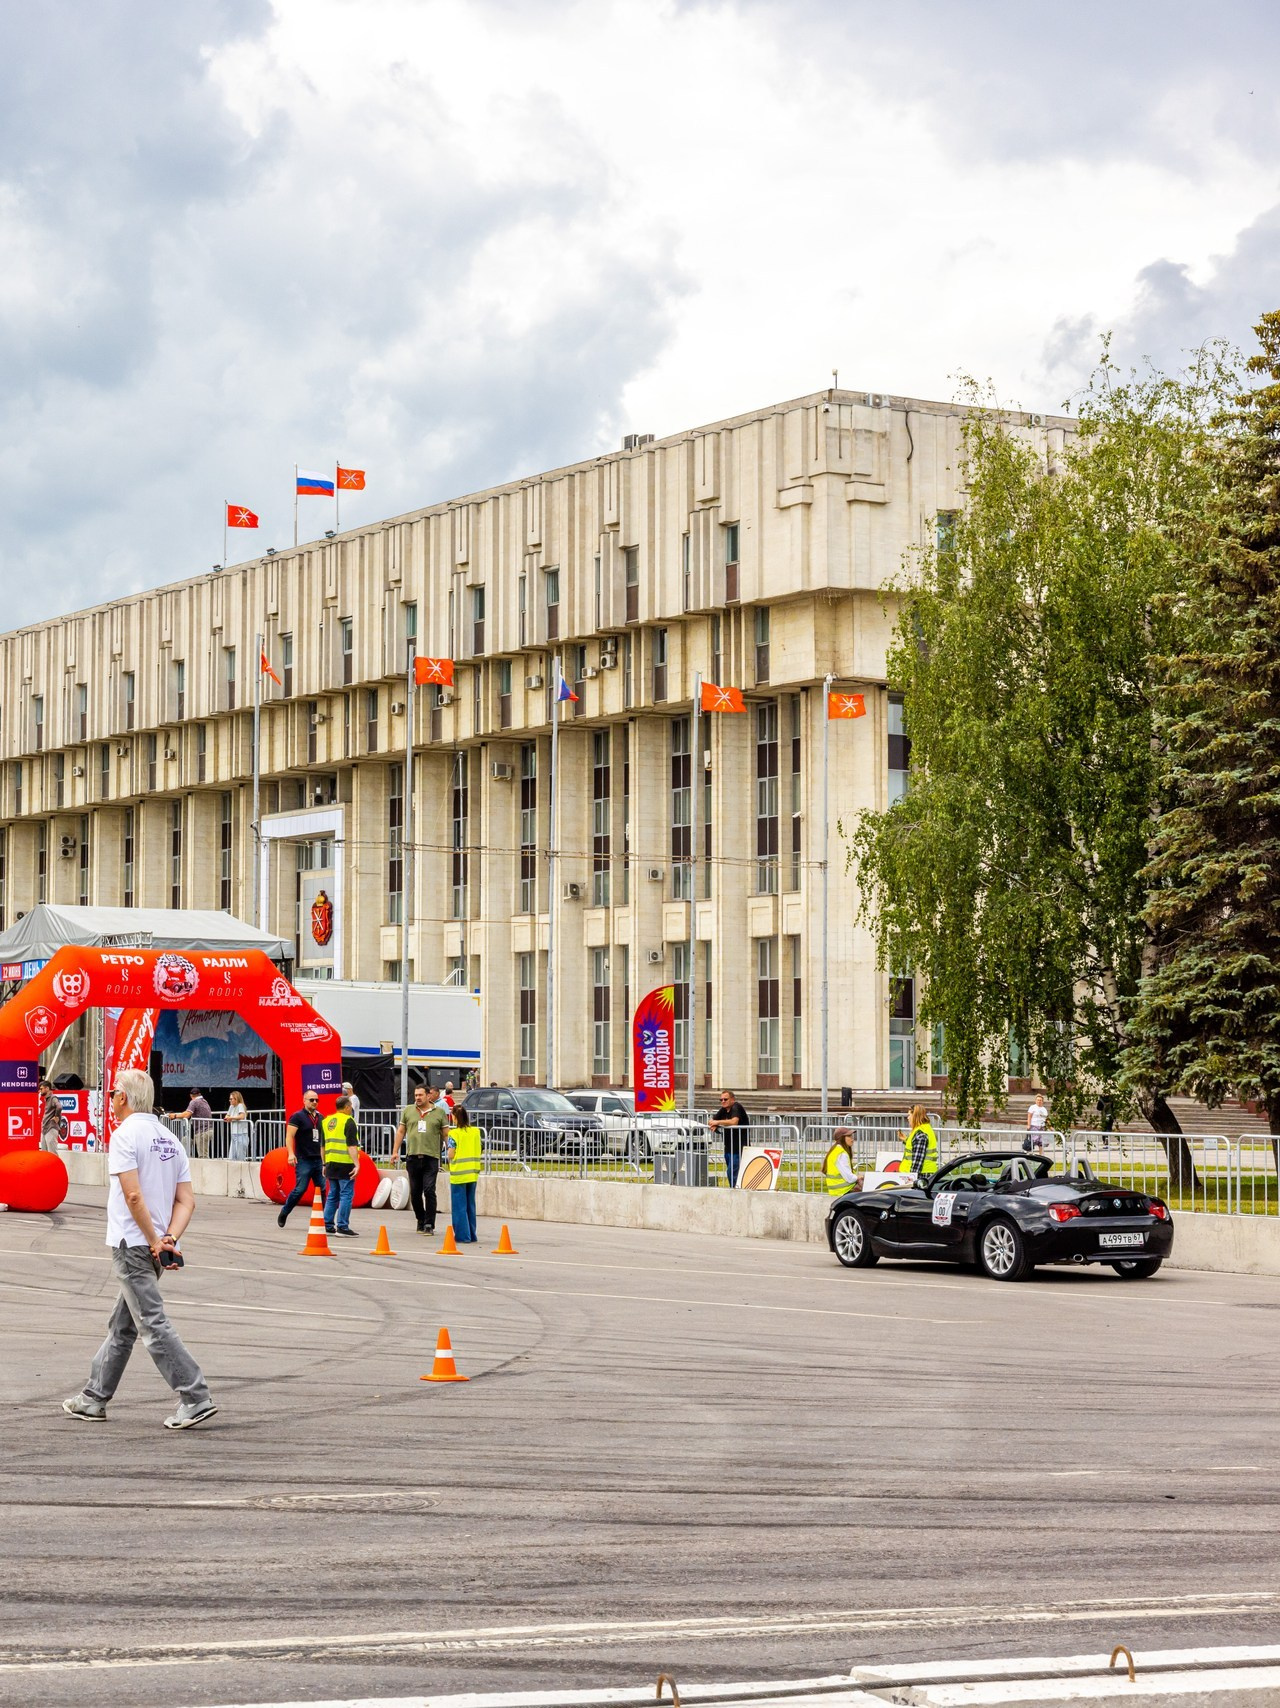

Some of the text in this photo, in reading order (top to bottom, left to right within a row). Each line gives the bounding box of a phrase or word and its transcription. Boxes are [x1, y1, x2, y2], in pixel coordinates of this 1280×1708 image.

[100, 954, 145, 966] РЕТРО
[203, 957, 248, 968] РАЛЛИ
[106, 984, 142, 995] RODIS
[208, 987, 244, 997] RODIS
[656, 1029, 670, 1089] ВЫГОДНО
[162, 1062, 185, 1073] uto.ru
[643, 1047, 657, 1088] АЛЬФА
